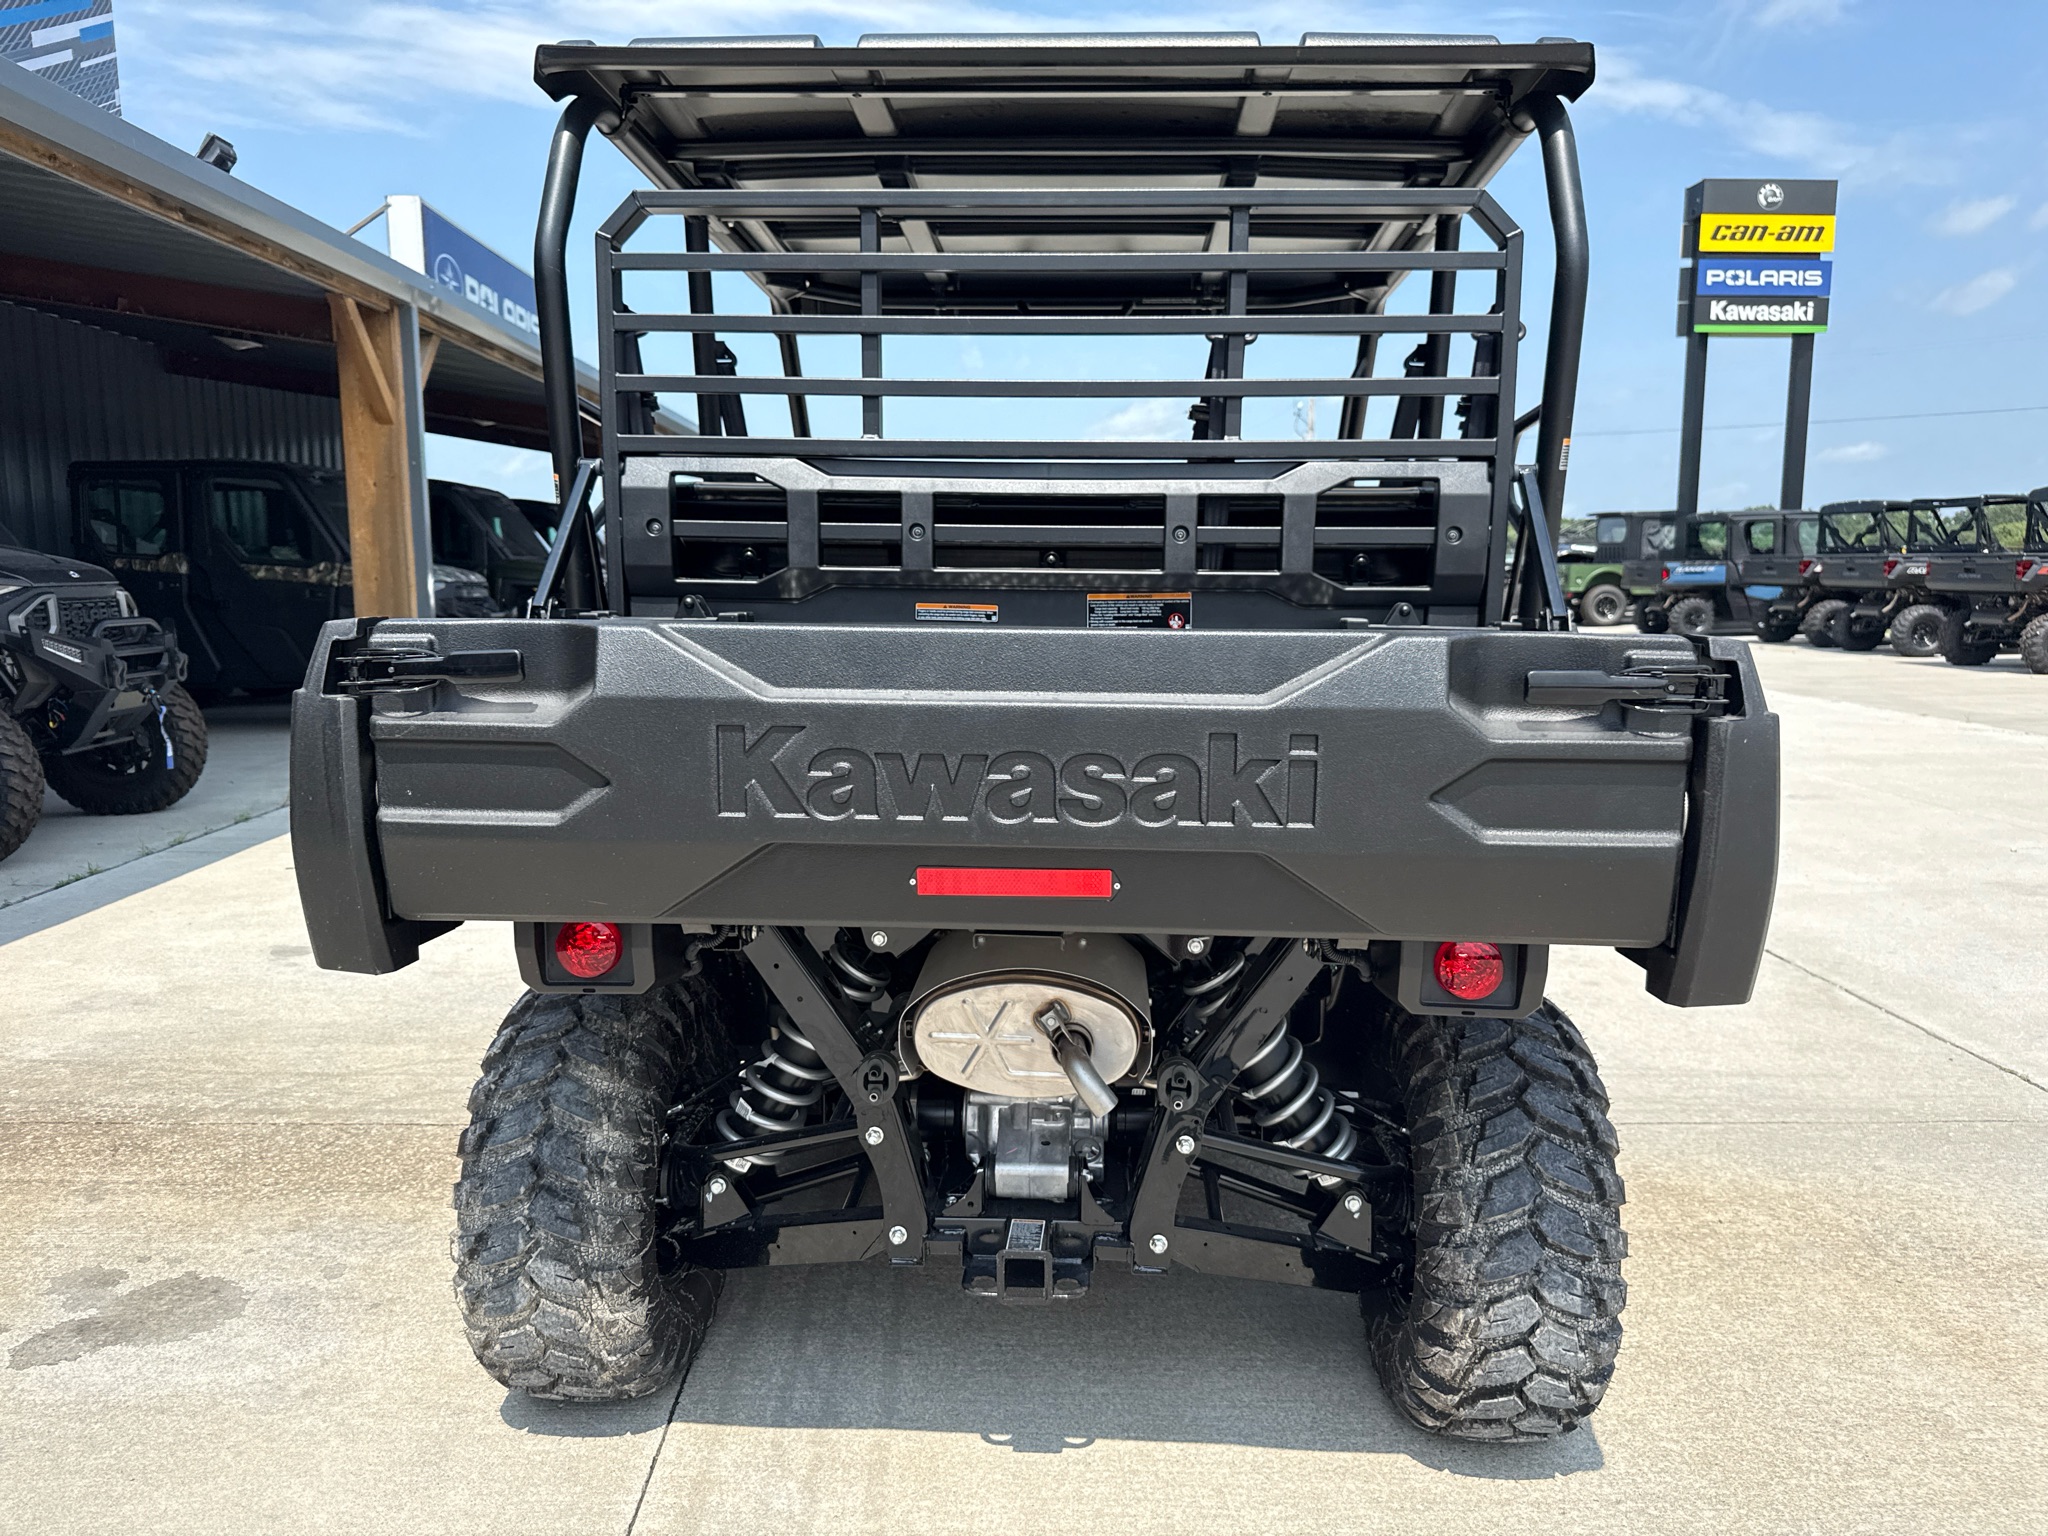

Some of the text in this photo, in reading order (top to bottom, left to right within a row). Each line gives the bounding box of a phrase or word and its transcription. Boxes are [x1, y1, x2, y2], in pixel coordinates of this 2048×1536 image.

[1710, 225, 1825, 242] can-am
[1706, 269, 1823, 286] POLARIS
[1710, 300, 1814, 321] Kawasaki
[716, 724, 1320, 829] Kawasaki
